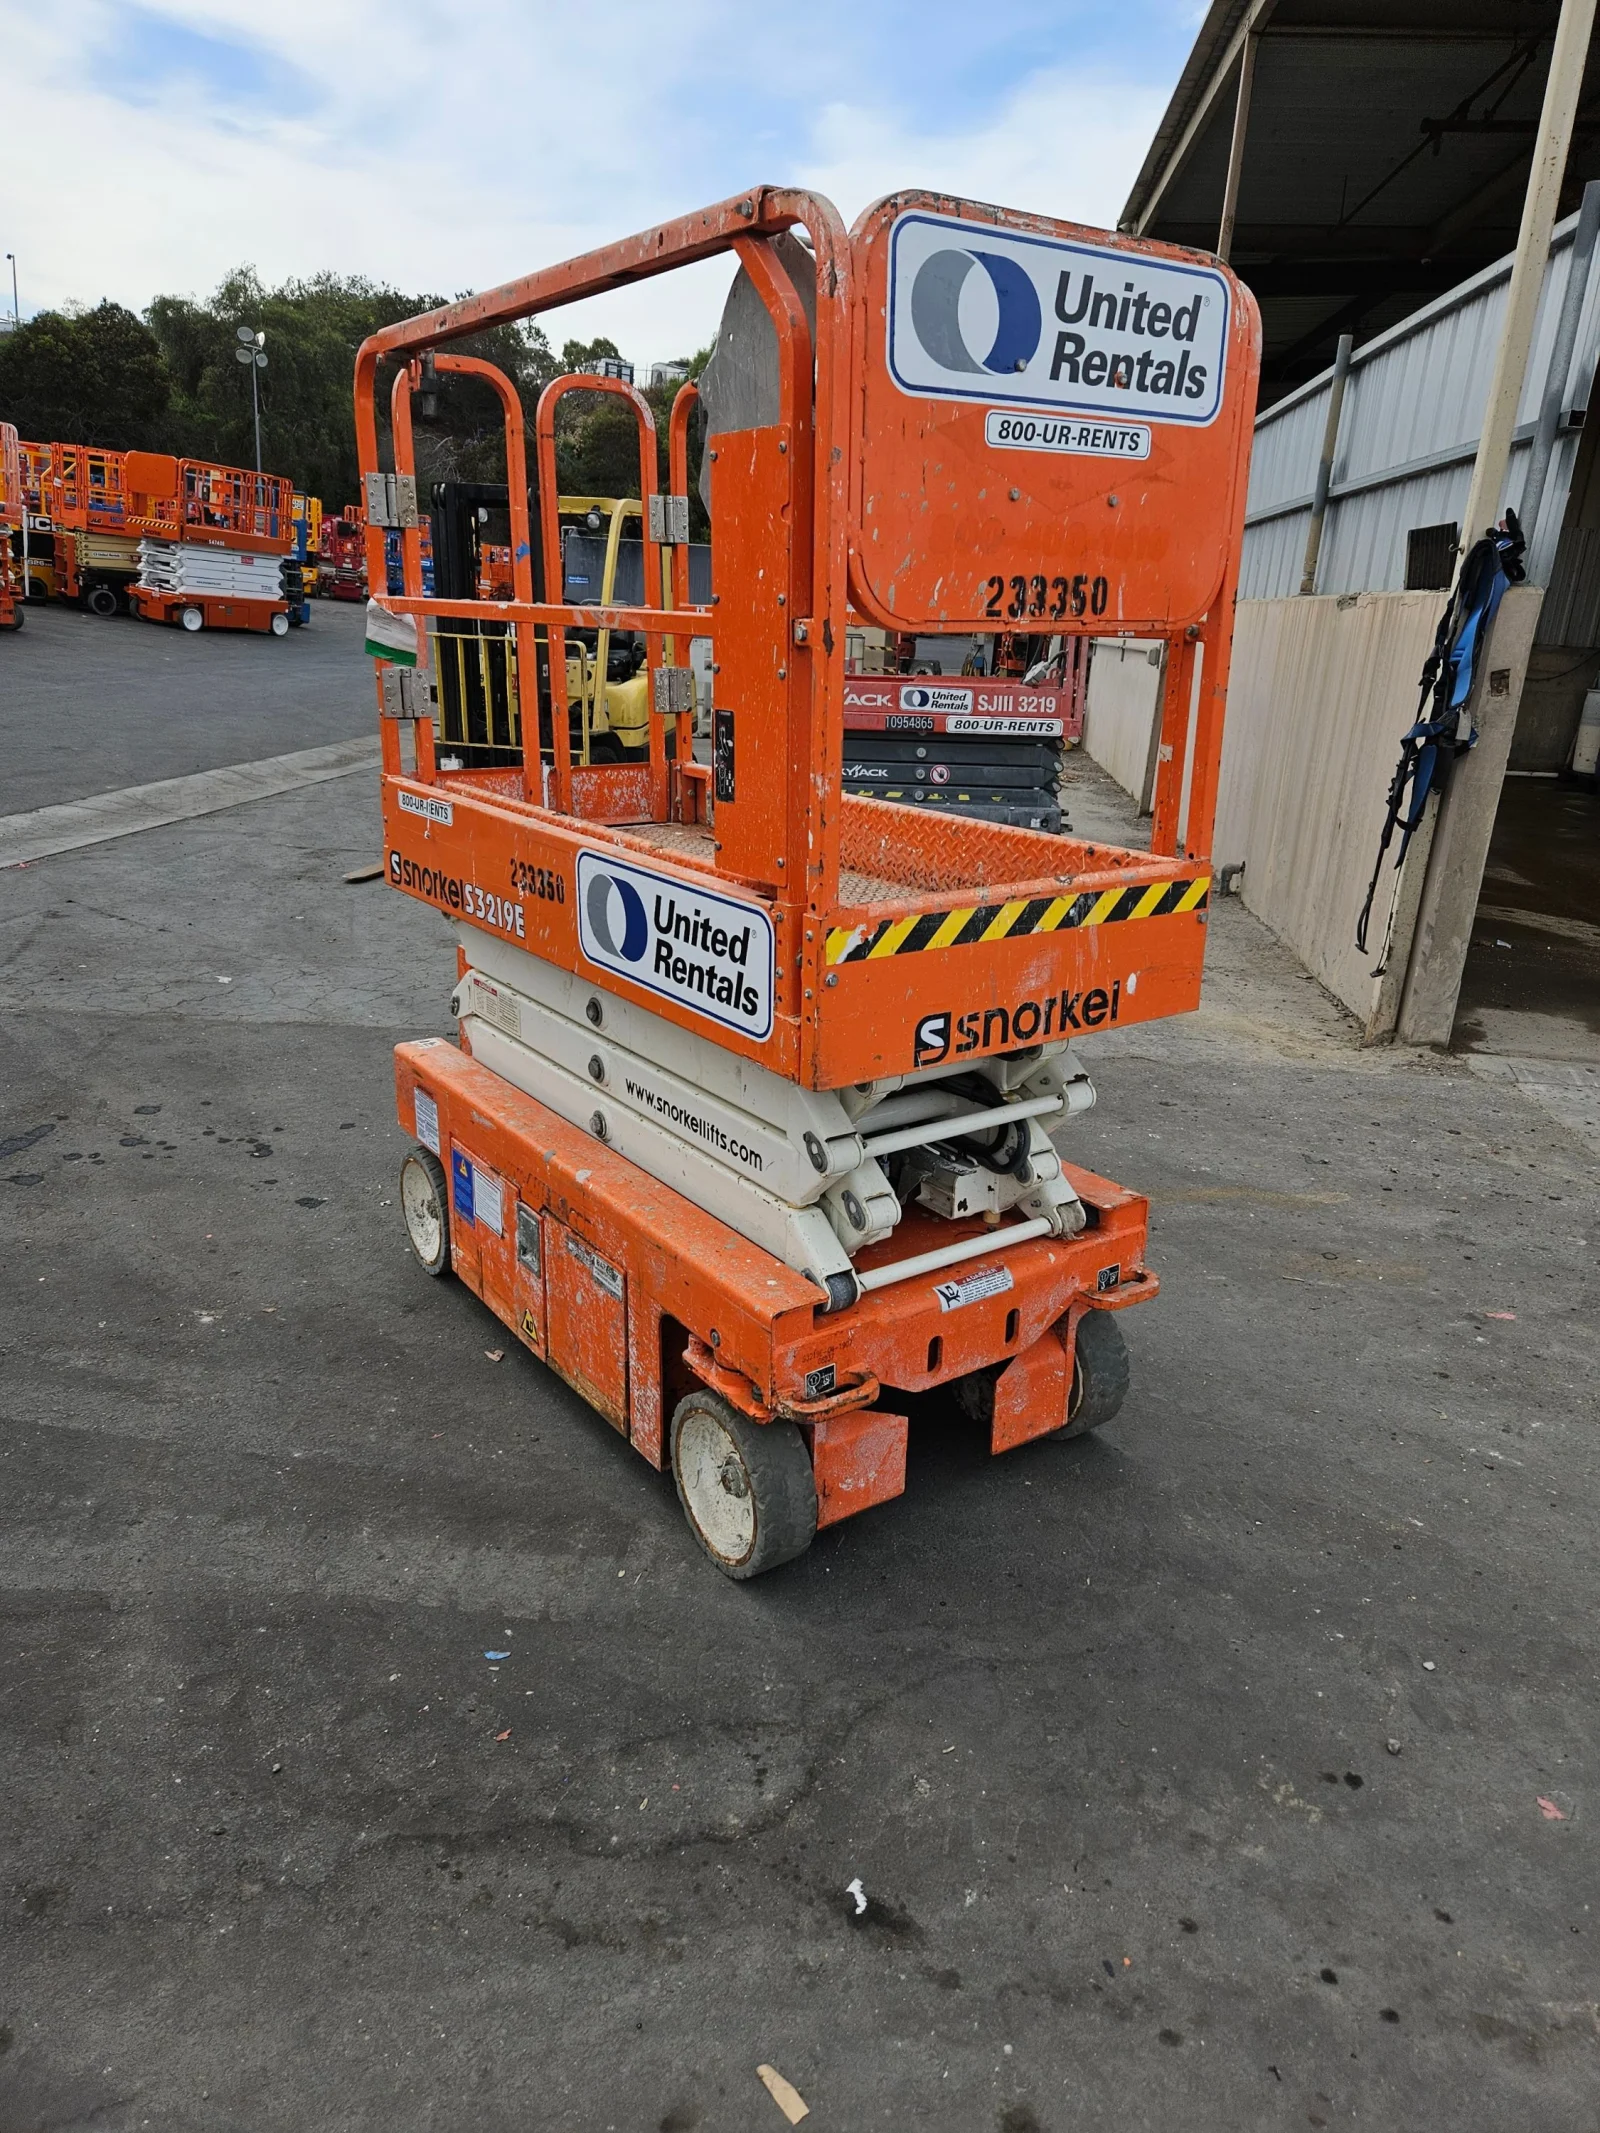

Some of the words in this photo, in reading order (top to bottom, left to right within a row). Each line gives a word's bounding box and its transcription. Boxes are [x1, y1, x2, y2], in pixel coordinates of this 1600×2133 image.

[1054, 270, 1203, 343] United
[1049, 331, 1207, 399] Rentals
[998, 419, 1141, 451] 800-UR-RENTS
[985, 575, 1109, 619] 233350
[930, 700, 969, 712] Rentals
[931, 691, 967, 702] United
[977, 695, 1013, 712] SJIII
[1017, 696, 1056, 713] 3219
[885, 716, 934, 730] 10954865
[953, 720, 1055, 733] 800-UR-RENTS
[403, 859, 465, 911] snorkel
[463, 883, 526, 940] S3219E
[510, 858, 565, 904] 233350
[654, 894, 751, 967] United
[653, 937, 759, 1017] Rentals
[956, 979, 1121, 1053] snorkel
[625, 1076, 763, 1172] www.snorkellifts.com
